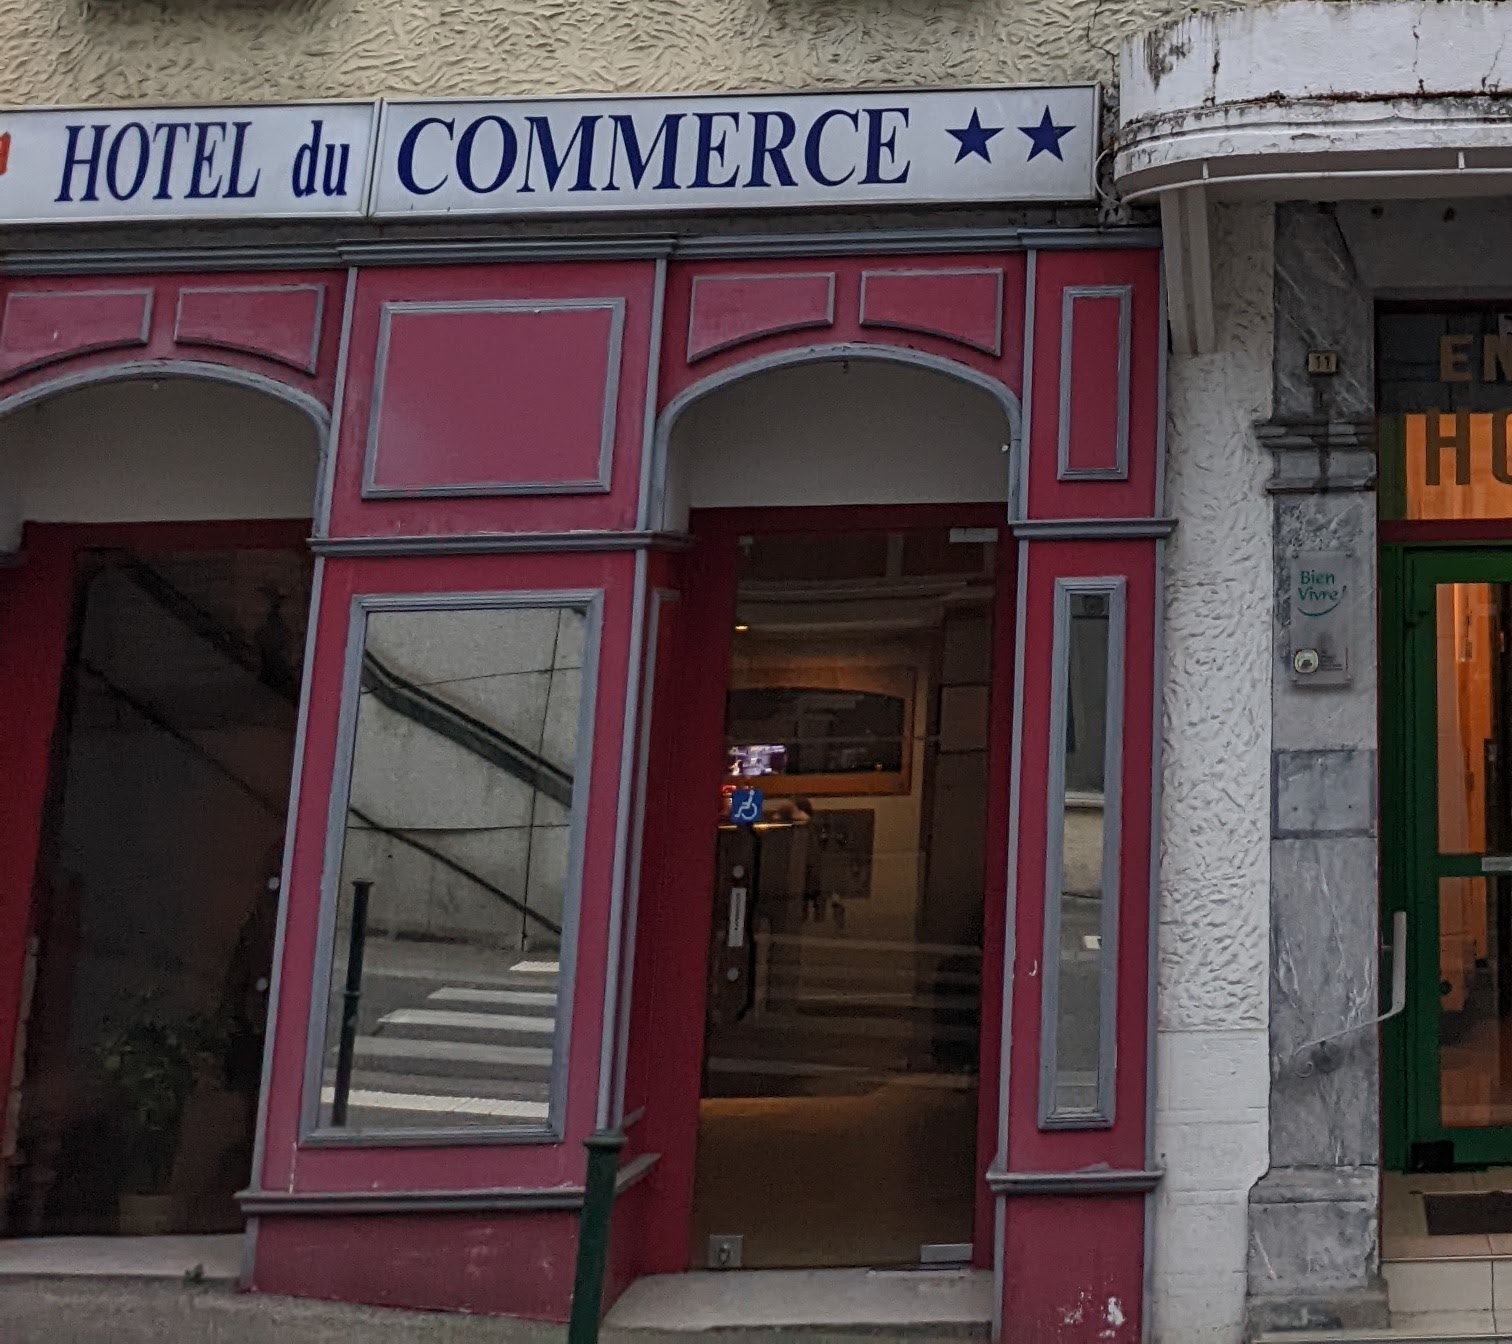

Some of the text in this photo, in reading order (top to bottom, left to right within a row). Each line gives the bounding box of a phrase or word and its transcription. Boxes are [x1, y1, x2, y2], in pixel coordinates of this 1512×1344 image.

[54, 121, 261, 202] HOTEL
[292, 120, 350, 198] du
[397, 108, 911, 195] COMMERCE
[1300, 570, 1335, 585] Bien
